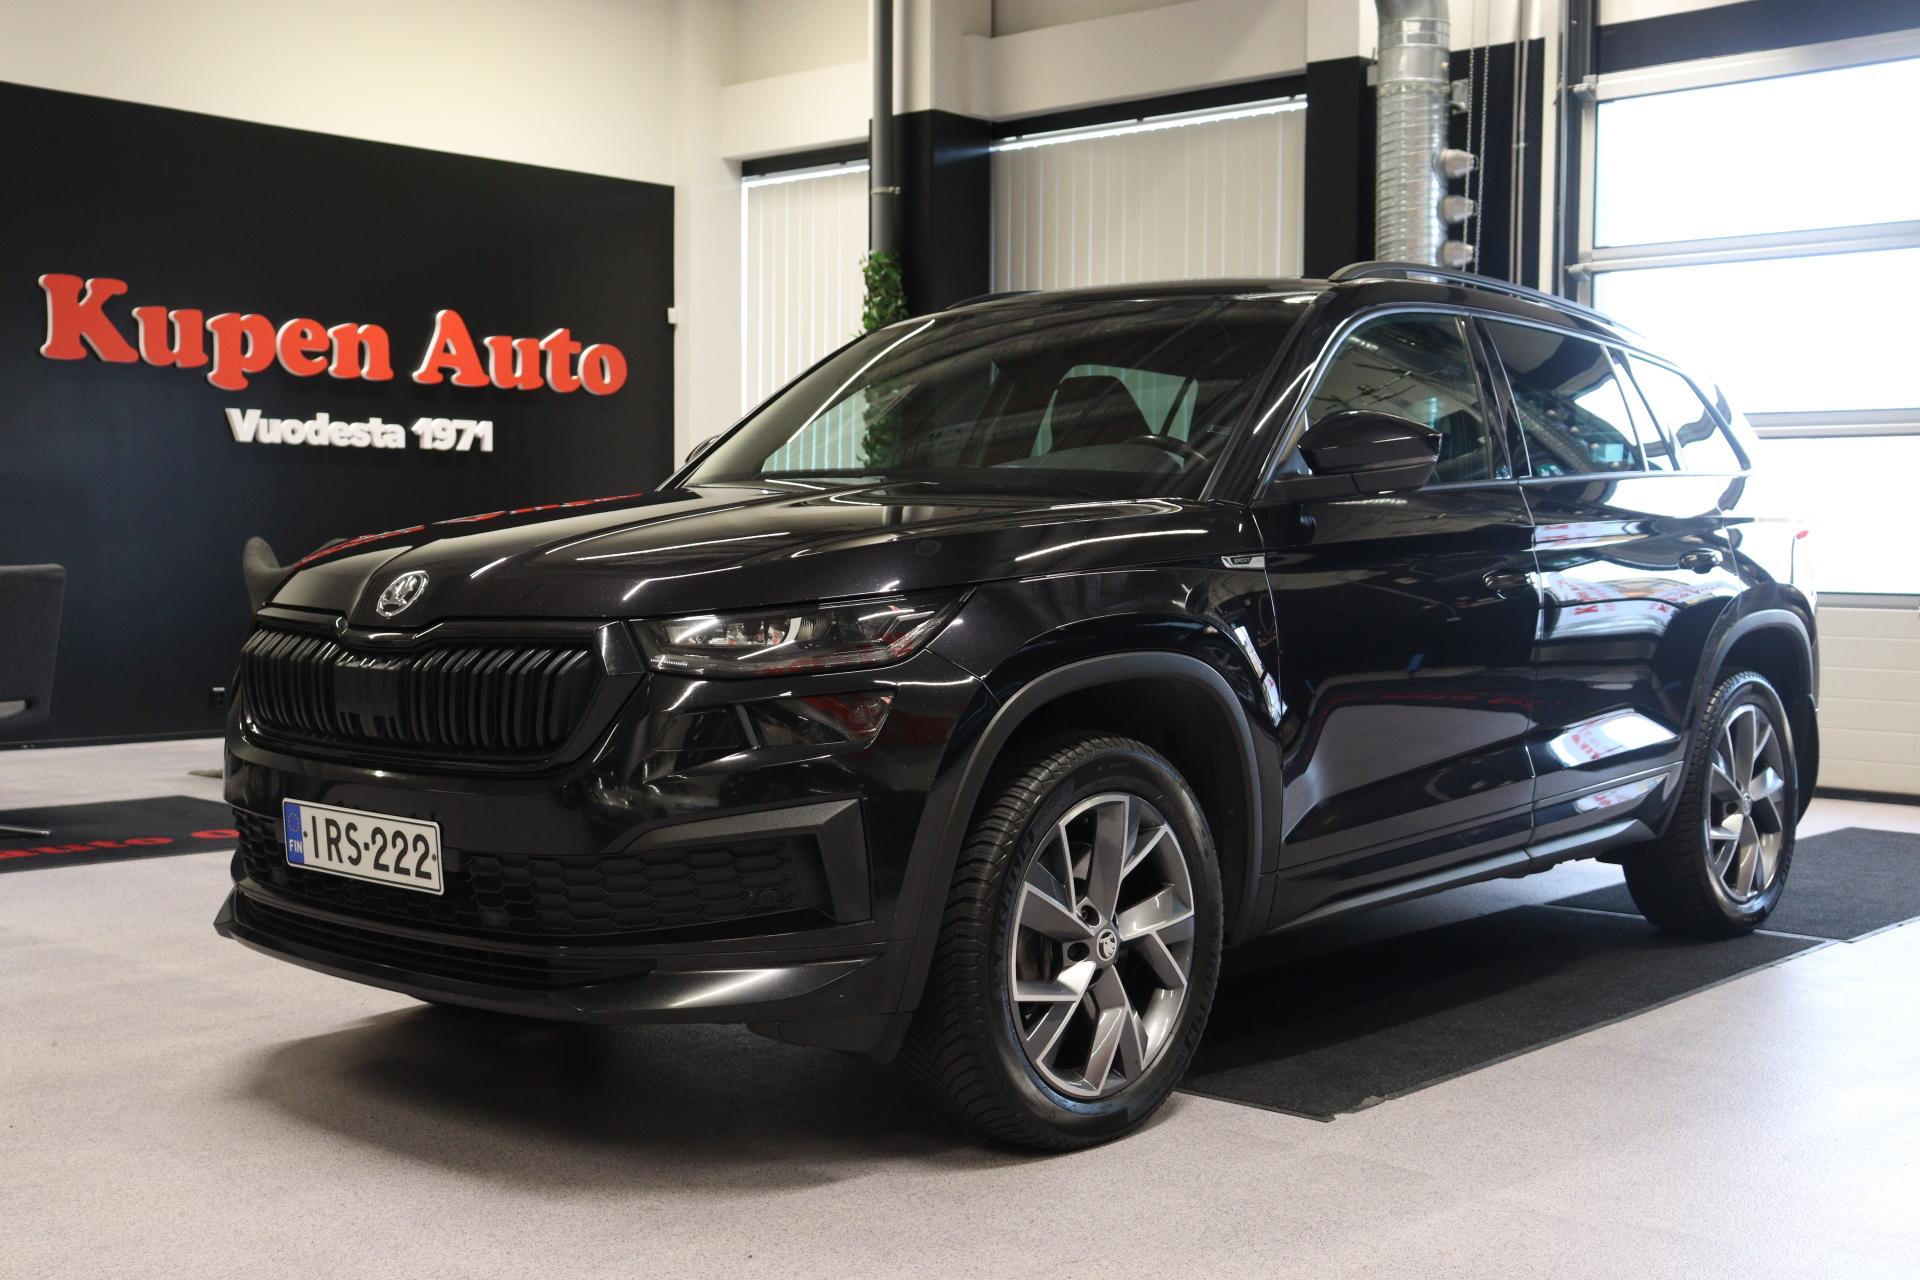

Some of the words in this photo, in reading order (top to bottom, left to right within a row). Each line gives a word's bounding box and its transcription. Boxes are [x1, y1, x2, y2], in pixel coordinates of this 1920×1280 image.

[39, 273, 394, 391] Kupen
[412, 309, 628, 395] Auto
[225, 407, 406, 449] Vuodesta
[411, 417, 493, 452] 1971
[288, 839, 303, 854] FIN
[311, 815, 432, 880] IRS-222
